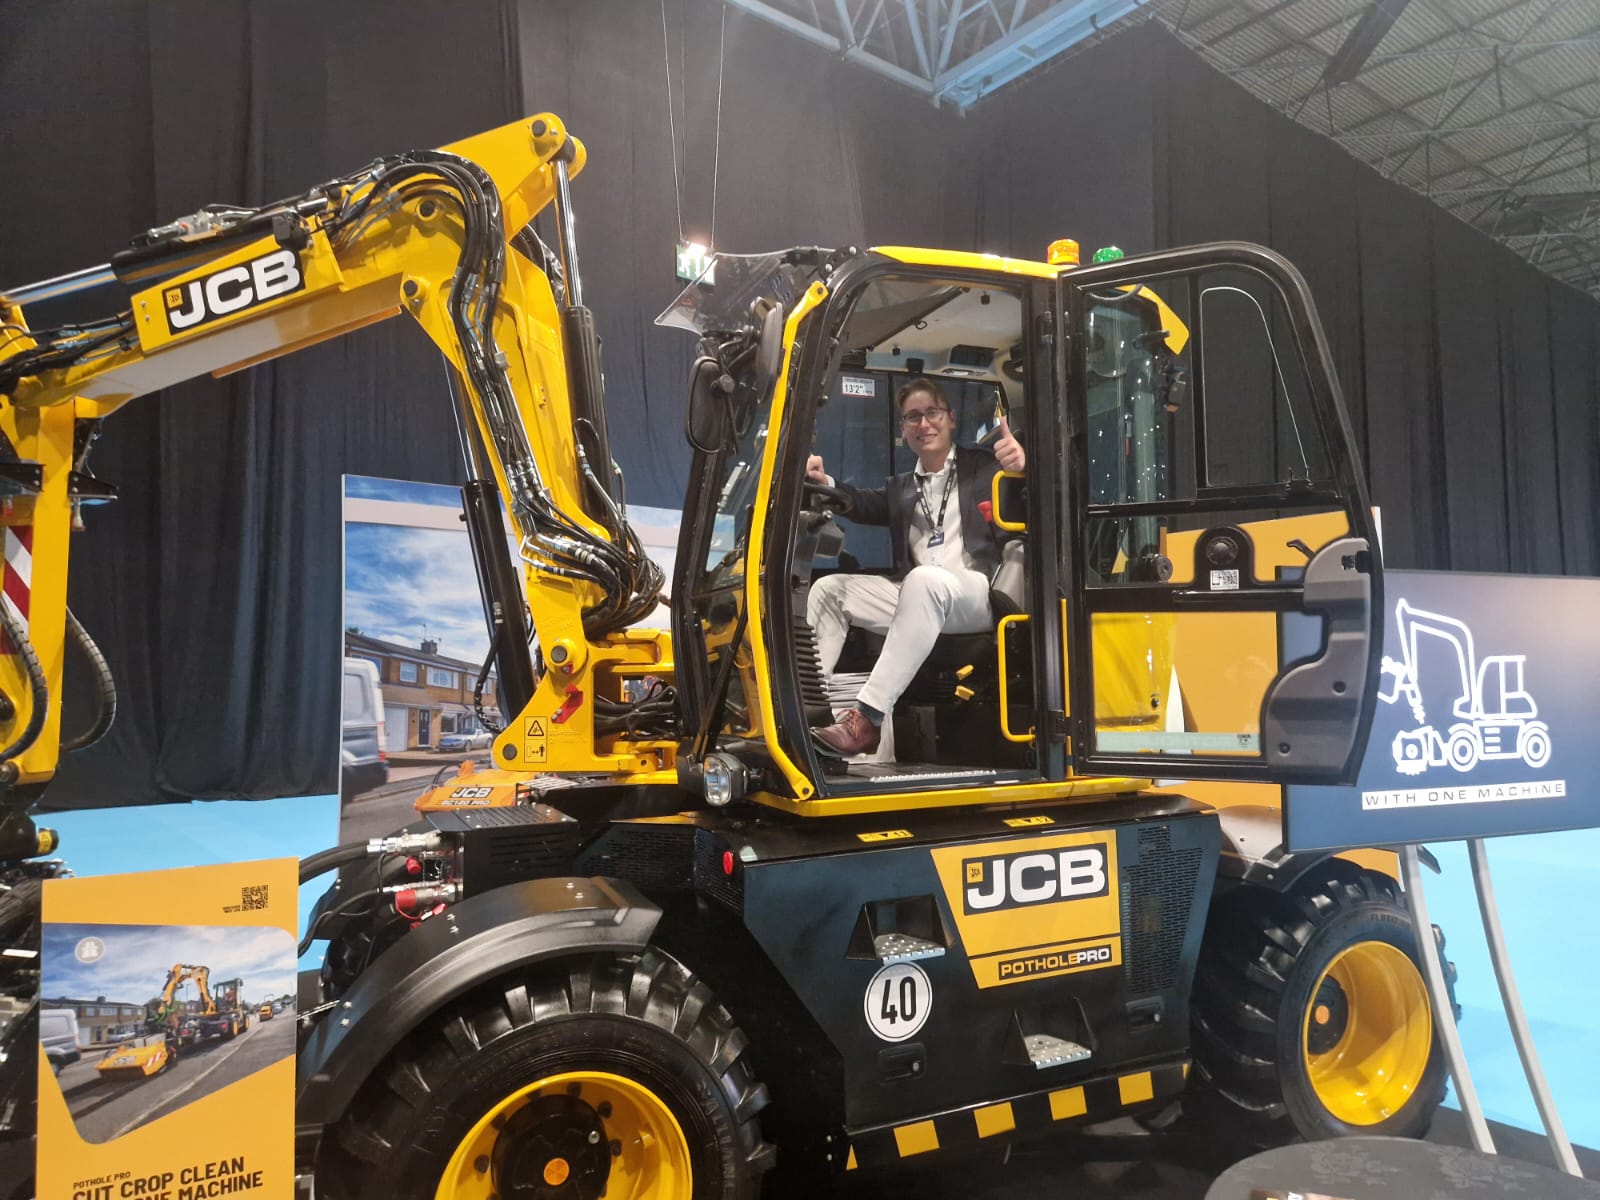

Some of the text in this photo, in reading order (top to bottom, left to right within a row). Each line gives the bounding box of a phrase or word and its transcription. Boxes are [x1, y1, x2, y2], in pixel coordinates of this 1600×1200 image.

[169, 250, 301, 329] JCB
[451, 787, 493, 798] JCB
[1365, 783, 1564, 806] WITH ONE MACHINE
[967, 849, 1106, 909] JCB
[1001, 948, 1110, 977] POTHOLEPRO
[881, 976, 917, 1025] 40
[72, 1171, 132, 1190] POTHOLE PRO
[120, 1172, 175, 1199] CROP
[180, 1156, 245, 1185] CLEAN
[178, 1170, 264, 1200] MACHINE
